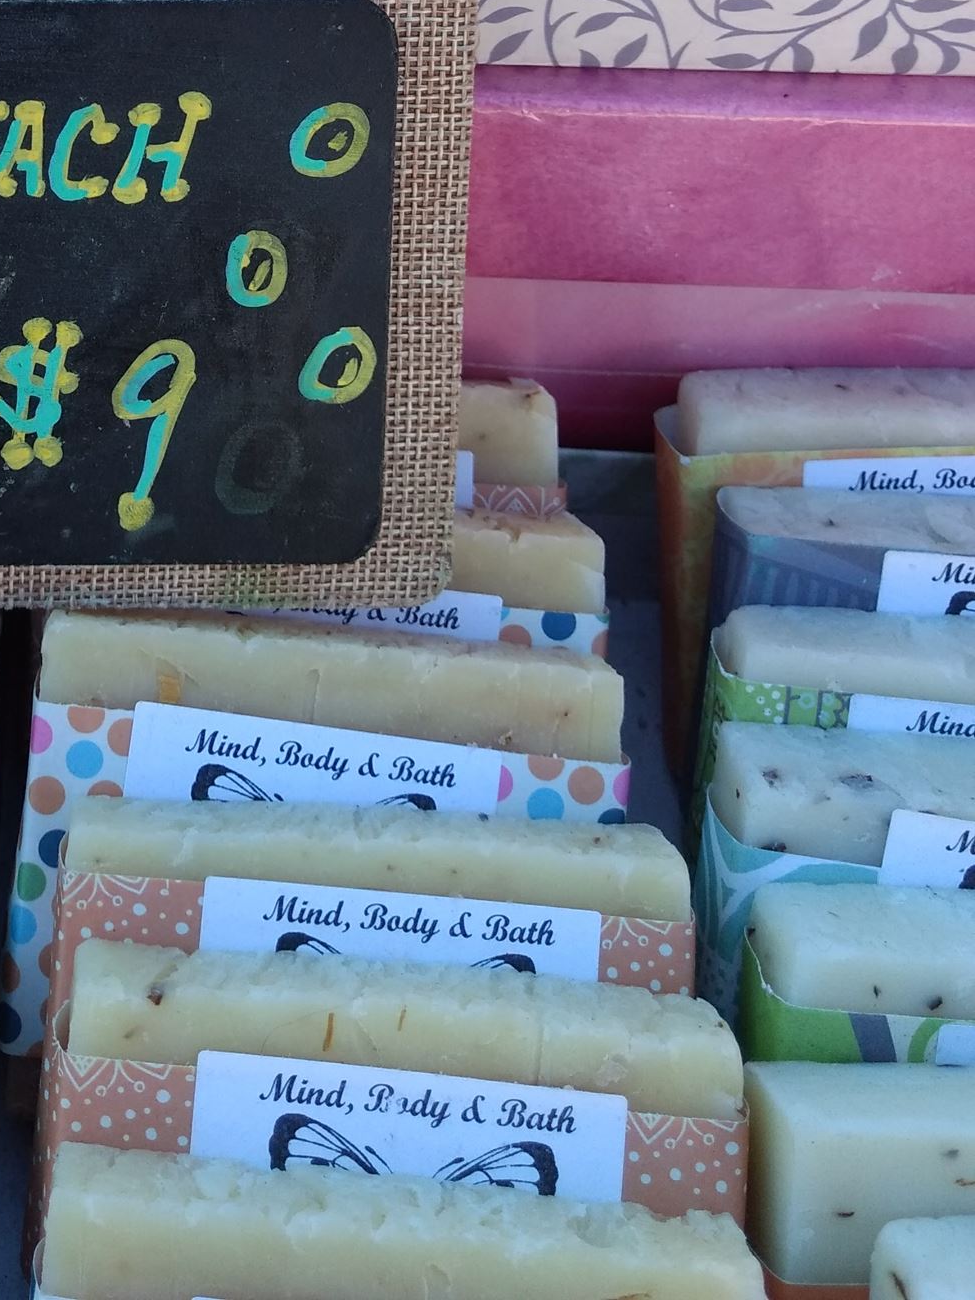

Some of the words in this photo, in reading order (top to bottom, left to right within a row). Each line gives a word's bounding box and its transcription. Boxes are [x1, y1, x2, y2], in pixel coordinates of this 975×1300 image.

[849, 469, 925, 493] Mind,
[932, 562, 975, 584] Mi
[396, 607, 460, 630] Bath
[185, 728, 266, 767] Mind,
[275, 740, 350, 781] Body
[358, 753, 380, 778] &
[388, 756, 456, 788] Bath
[263, 894, 351, 933] Mind,
[359, 903, 440, 943] Body
[449, 911, 473, 939] &
[481, 914, 555, 947] Bath
[259, 1073, 354, 1116] Mind,
[461, 1095, 486, 1125] &
[497, 1098, 577, 1135] Bath
